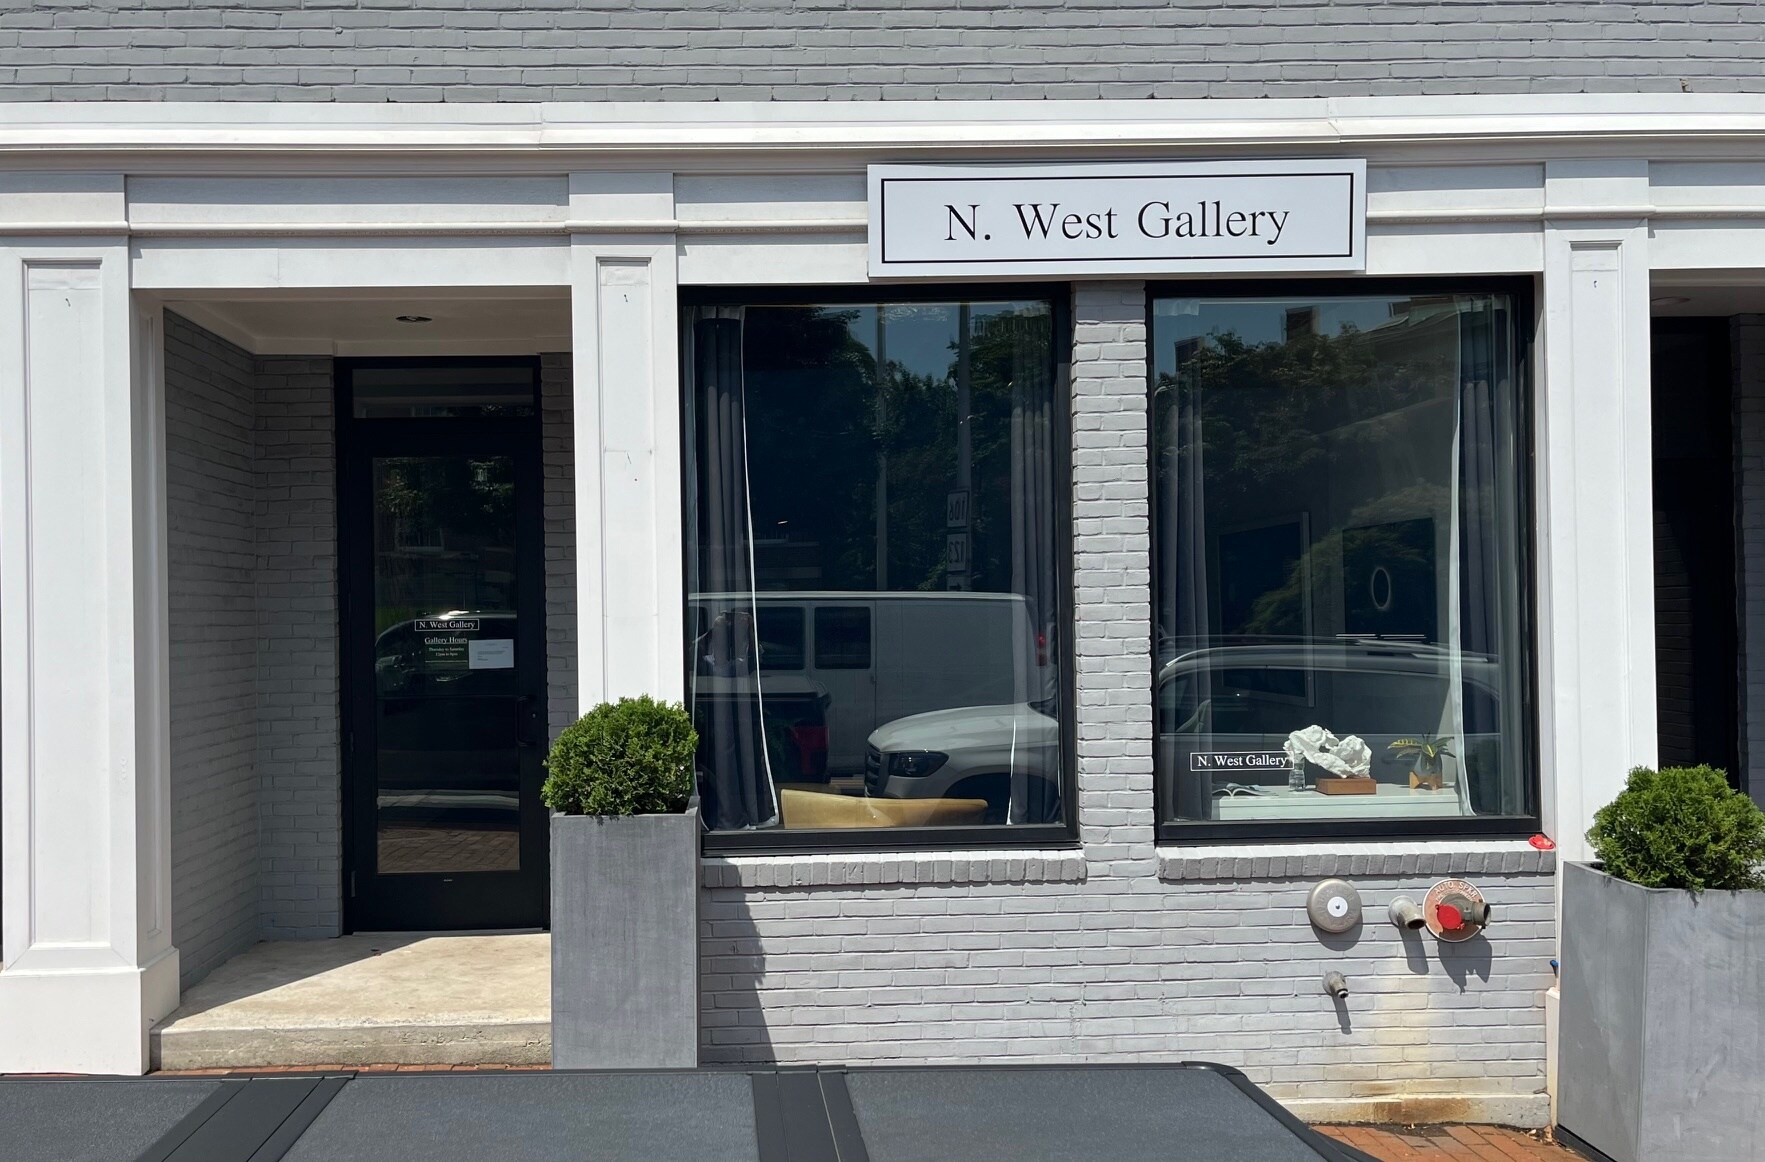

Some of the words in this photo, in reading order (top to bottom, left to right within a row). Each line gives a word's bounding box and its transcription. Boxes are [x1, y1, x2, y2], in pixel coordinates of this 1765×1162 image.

[944, 204, 992, 241] N.
[1012, 202, 1119, 240] West
[1137, 200, 1290, 245] Gallery
[419, 621, 428, 629] N.
[430, 621, 448, 629] West
[449, 621, 475, 629] Gallery
[424, 636, 447, 645] Gallery
[449, 636, 468, 644] Hours
[1197, 755, 1211, 767] N.
[1214, 754, 1243, 766] West
[1245, 753, 1288, 768] Gallery
